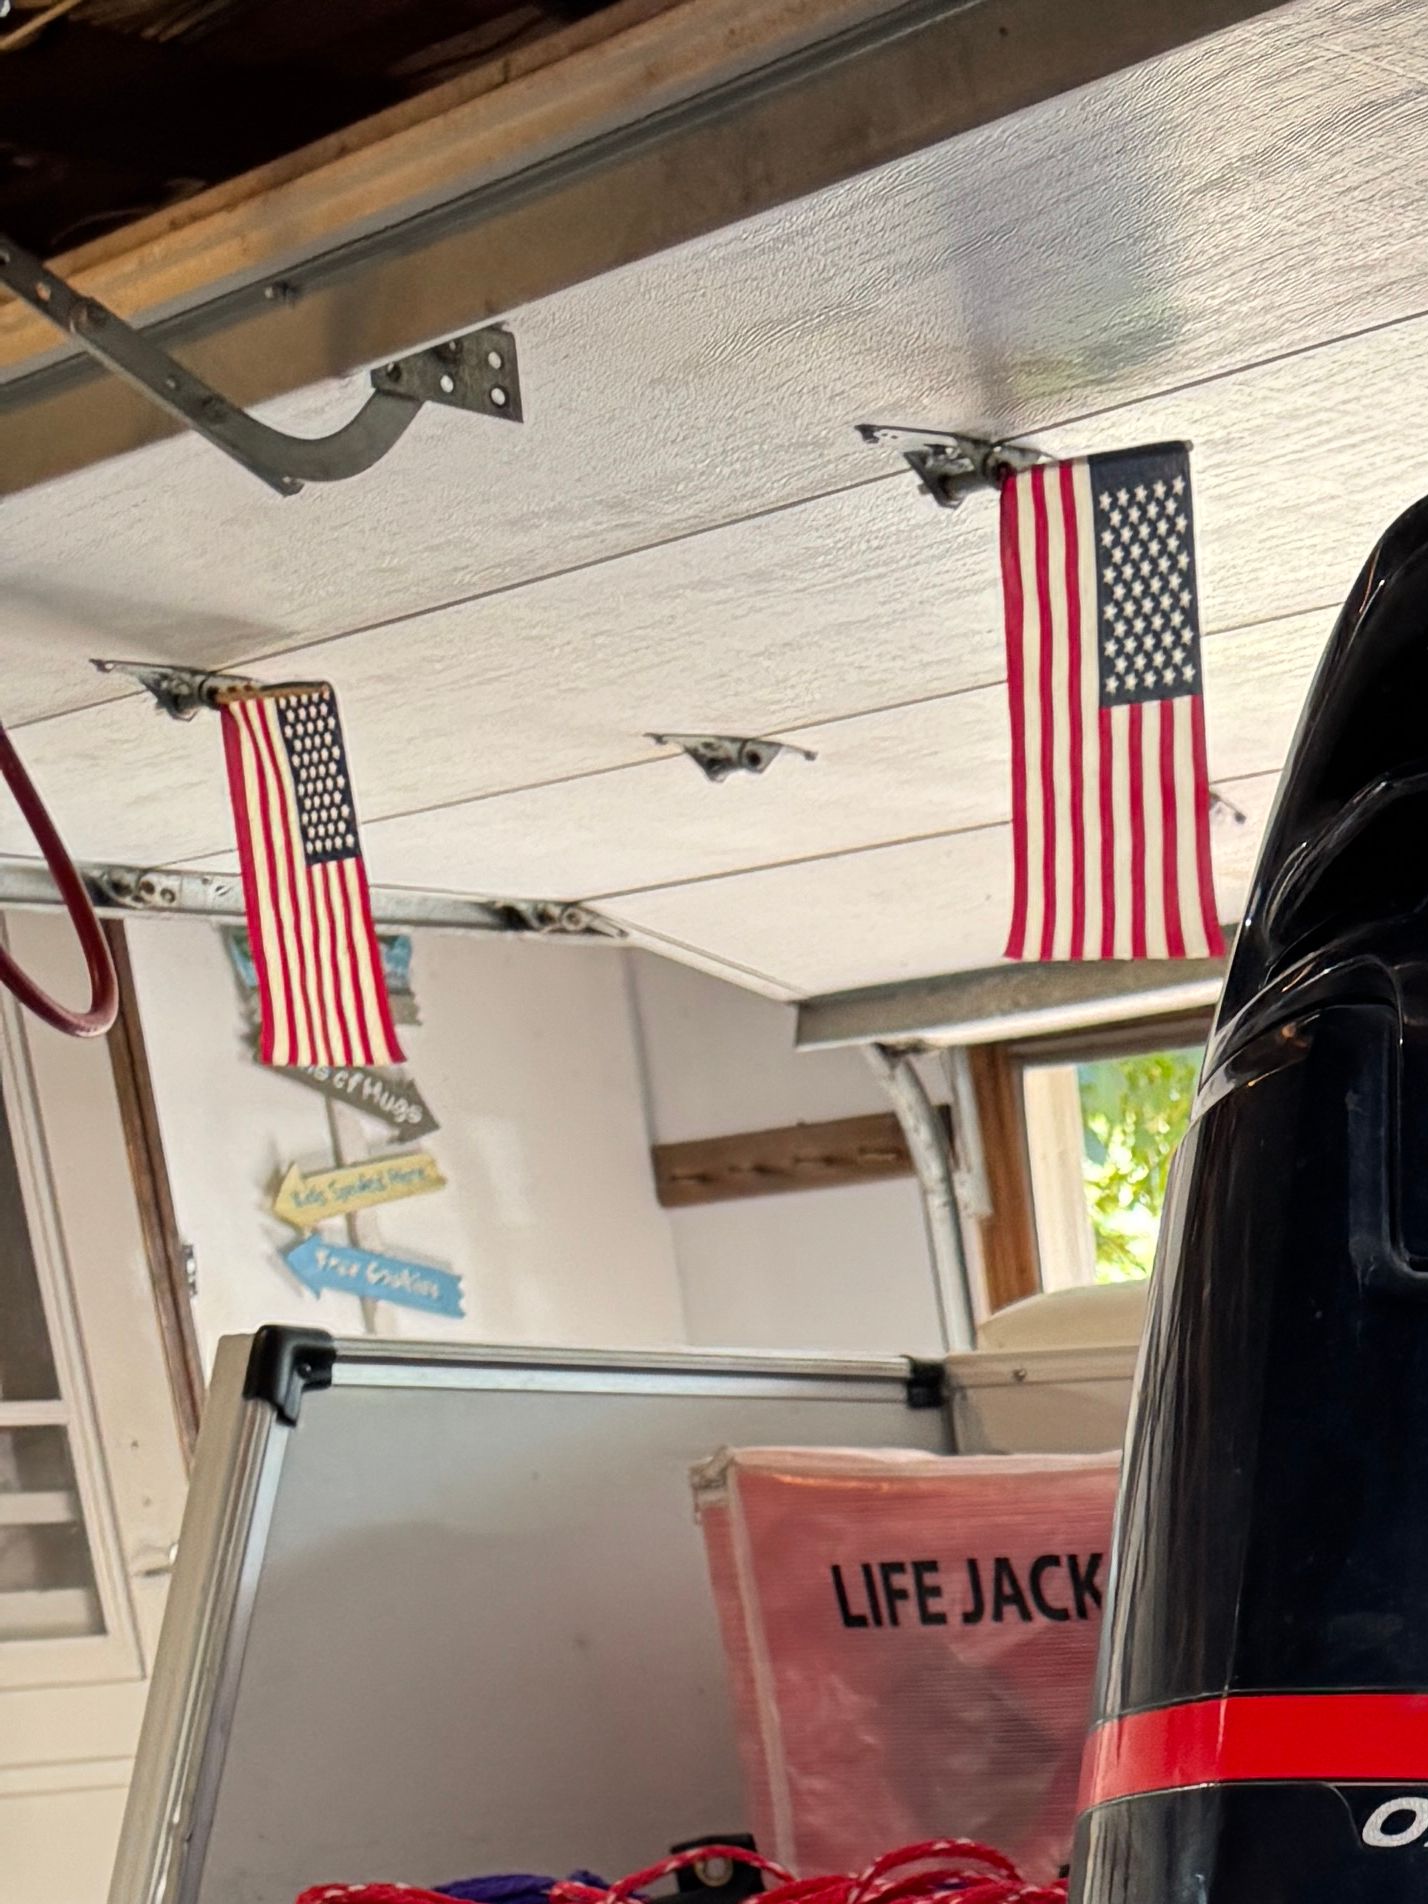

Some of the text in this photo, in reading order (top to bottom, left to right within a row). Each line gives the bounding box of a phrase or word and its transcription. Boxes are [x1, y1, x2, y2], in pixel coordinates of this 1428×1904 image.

[362, 1077, 423, 1124] Hugs
[830, 1552, 1104, 1628] LIFE JACK
